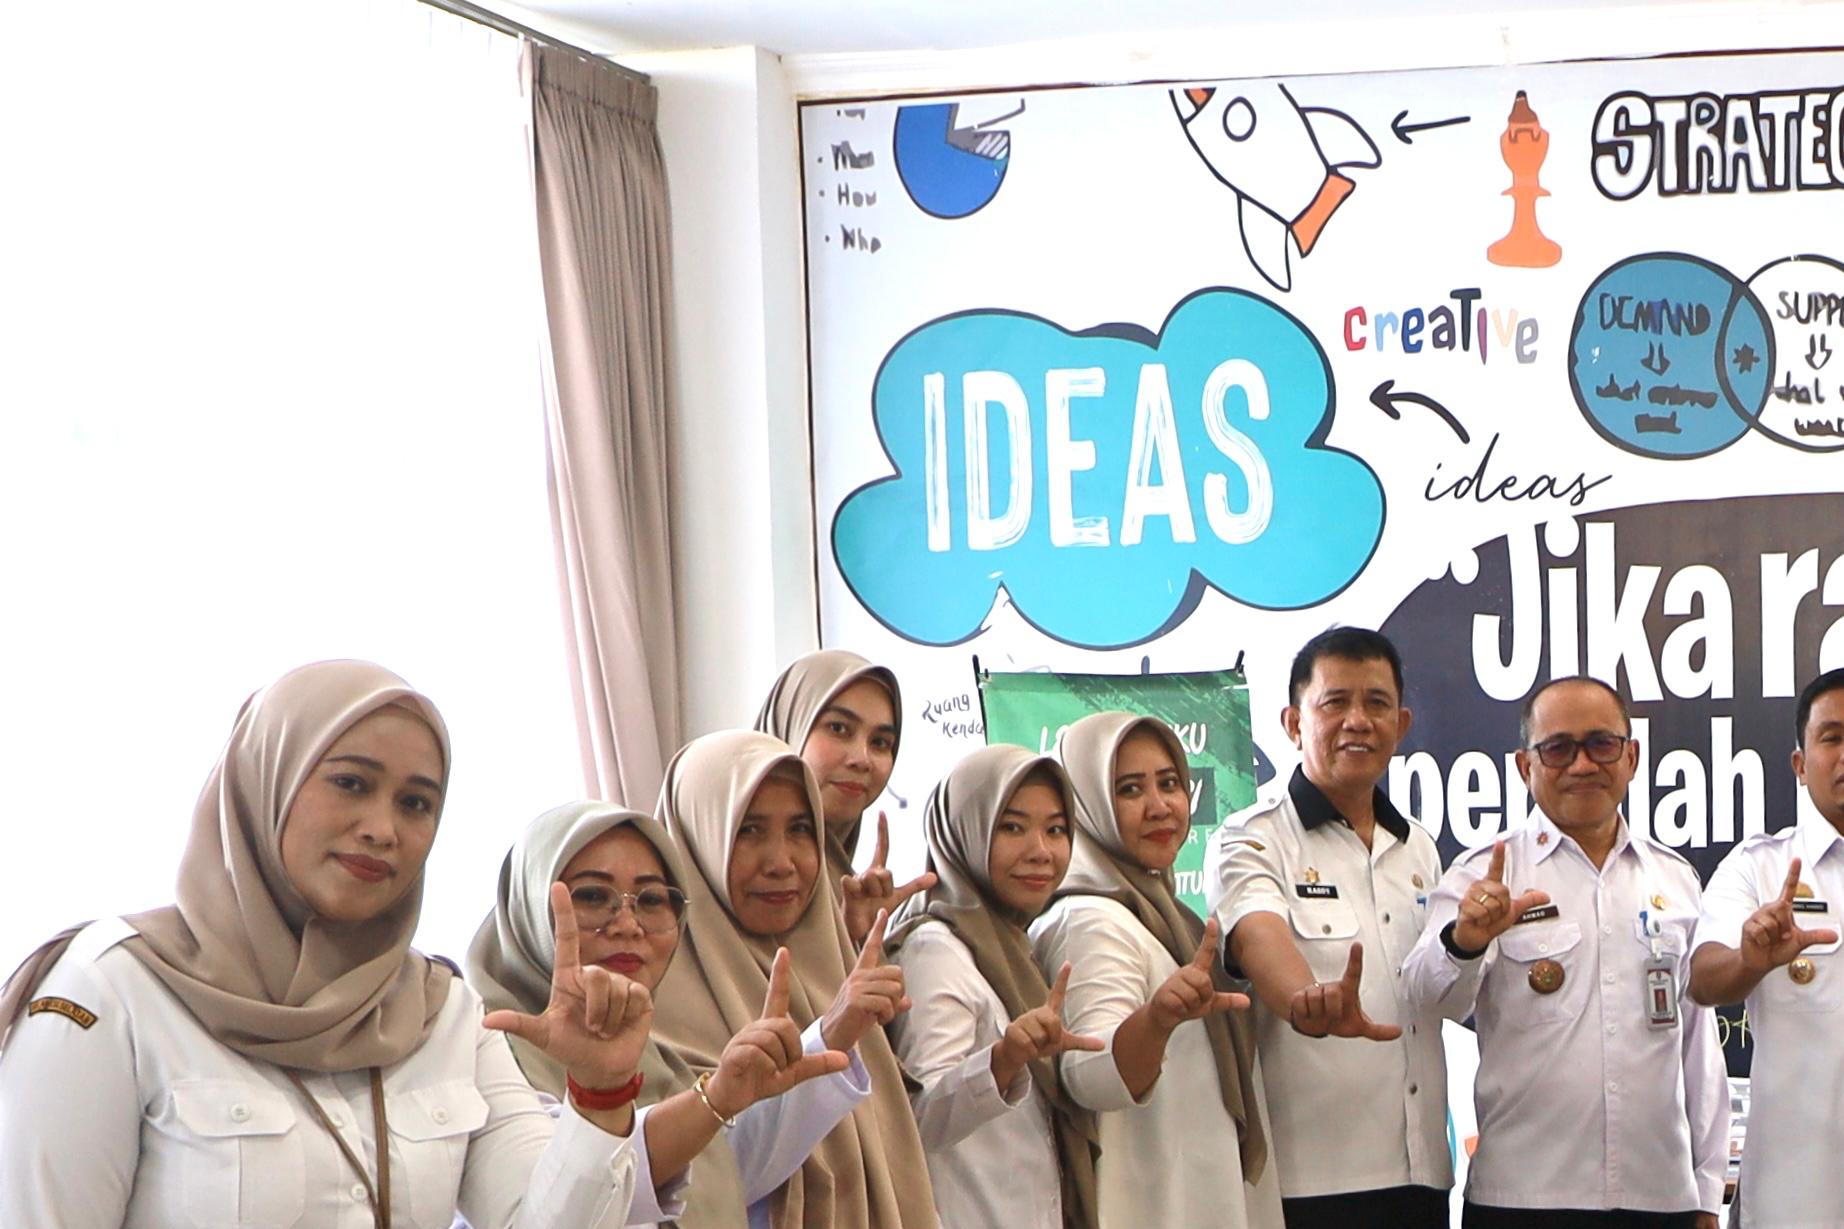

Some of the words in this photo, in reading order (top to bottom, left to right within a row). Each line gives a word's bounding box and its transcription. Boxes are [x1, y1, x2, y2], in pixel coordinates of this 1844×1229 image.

[1600, 292, 1711, 337] DEMAND
[923, 358, 1274, 552] IDEAS
[1424, 432, 1613, 504] ideas
[1471, 516, 1734, 702] Jika
